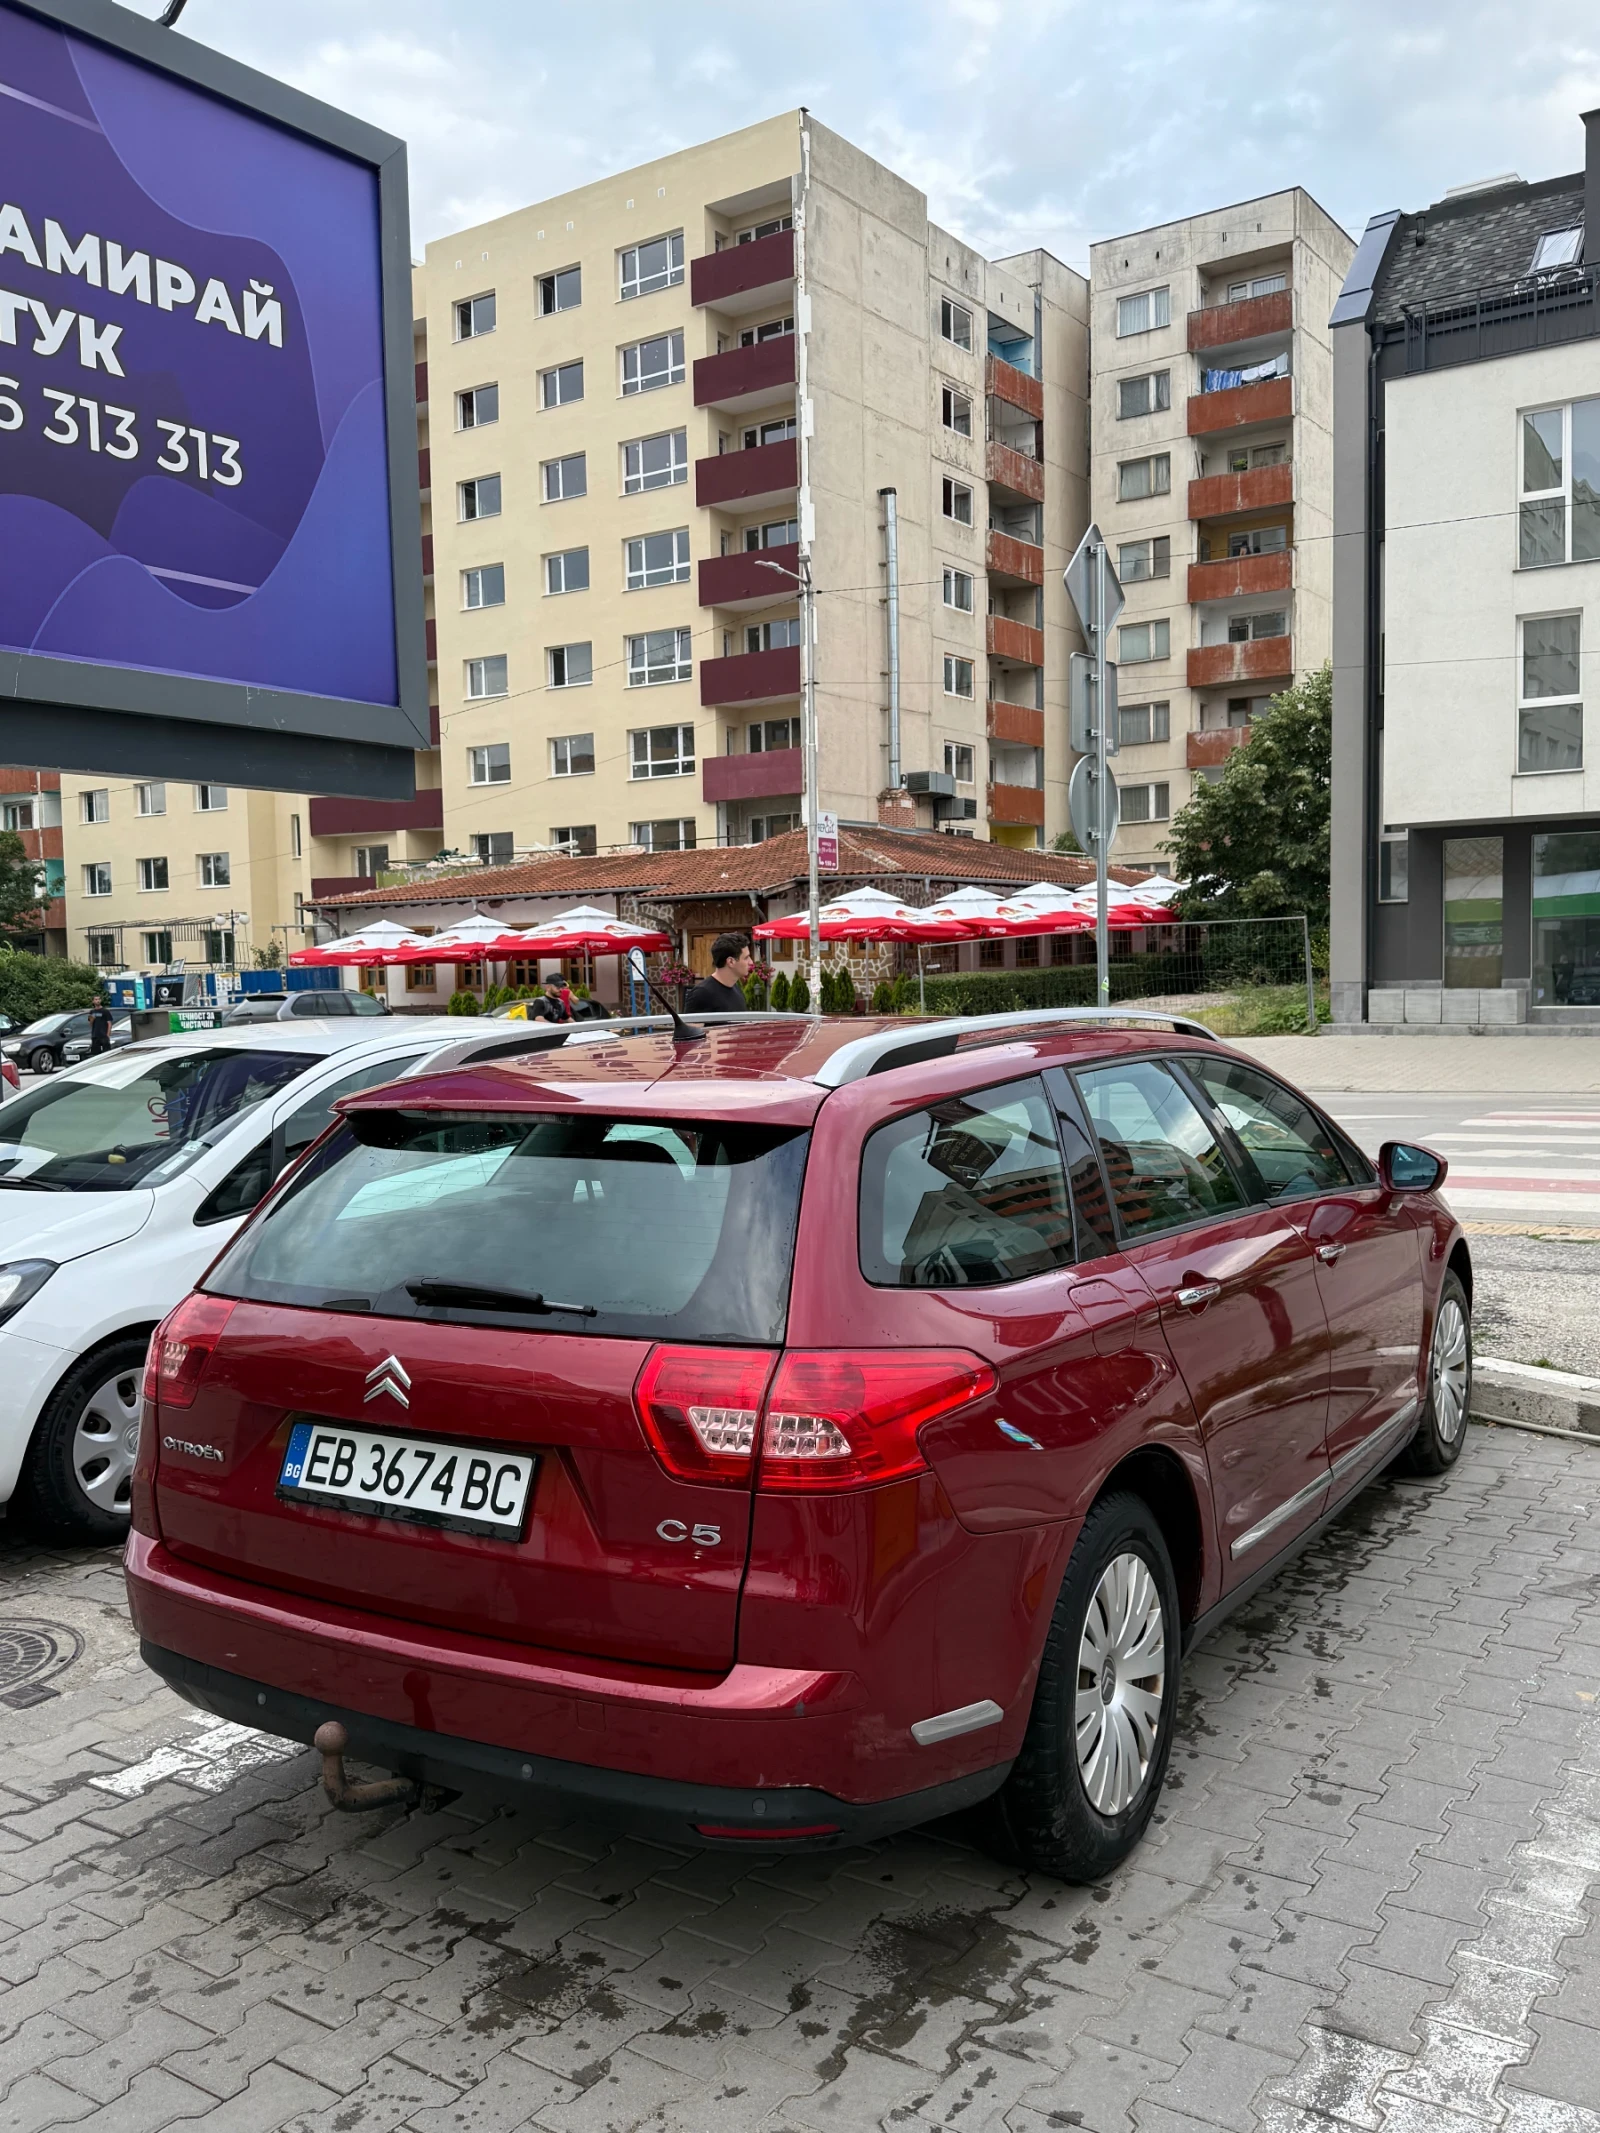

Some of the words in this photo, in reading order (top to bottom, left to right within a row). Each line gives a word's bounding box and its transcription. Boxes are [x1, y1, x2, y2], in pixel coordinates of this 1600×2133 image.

[43, 387, 139, 459] 313
[156, 418, 243, 486] 313
[163, 1436, 224, 1462] CITROËN
[284, 1463, 301, 1478] BG
[305, 1434, 357, 1488] EB
[360, 1442, 458, 1506] 3674
[461, 1459, 521, 1516] BC
[656, 1519, 721, 1546] C5
